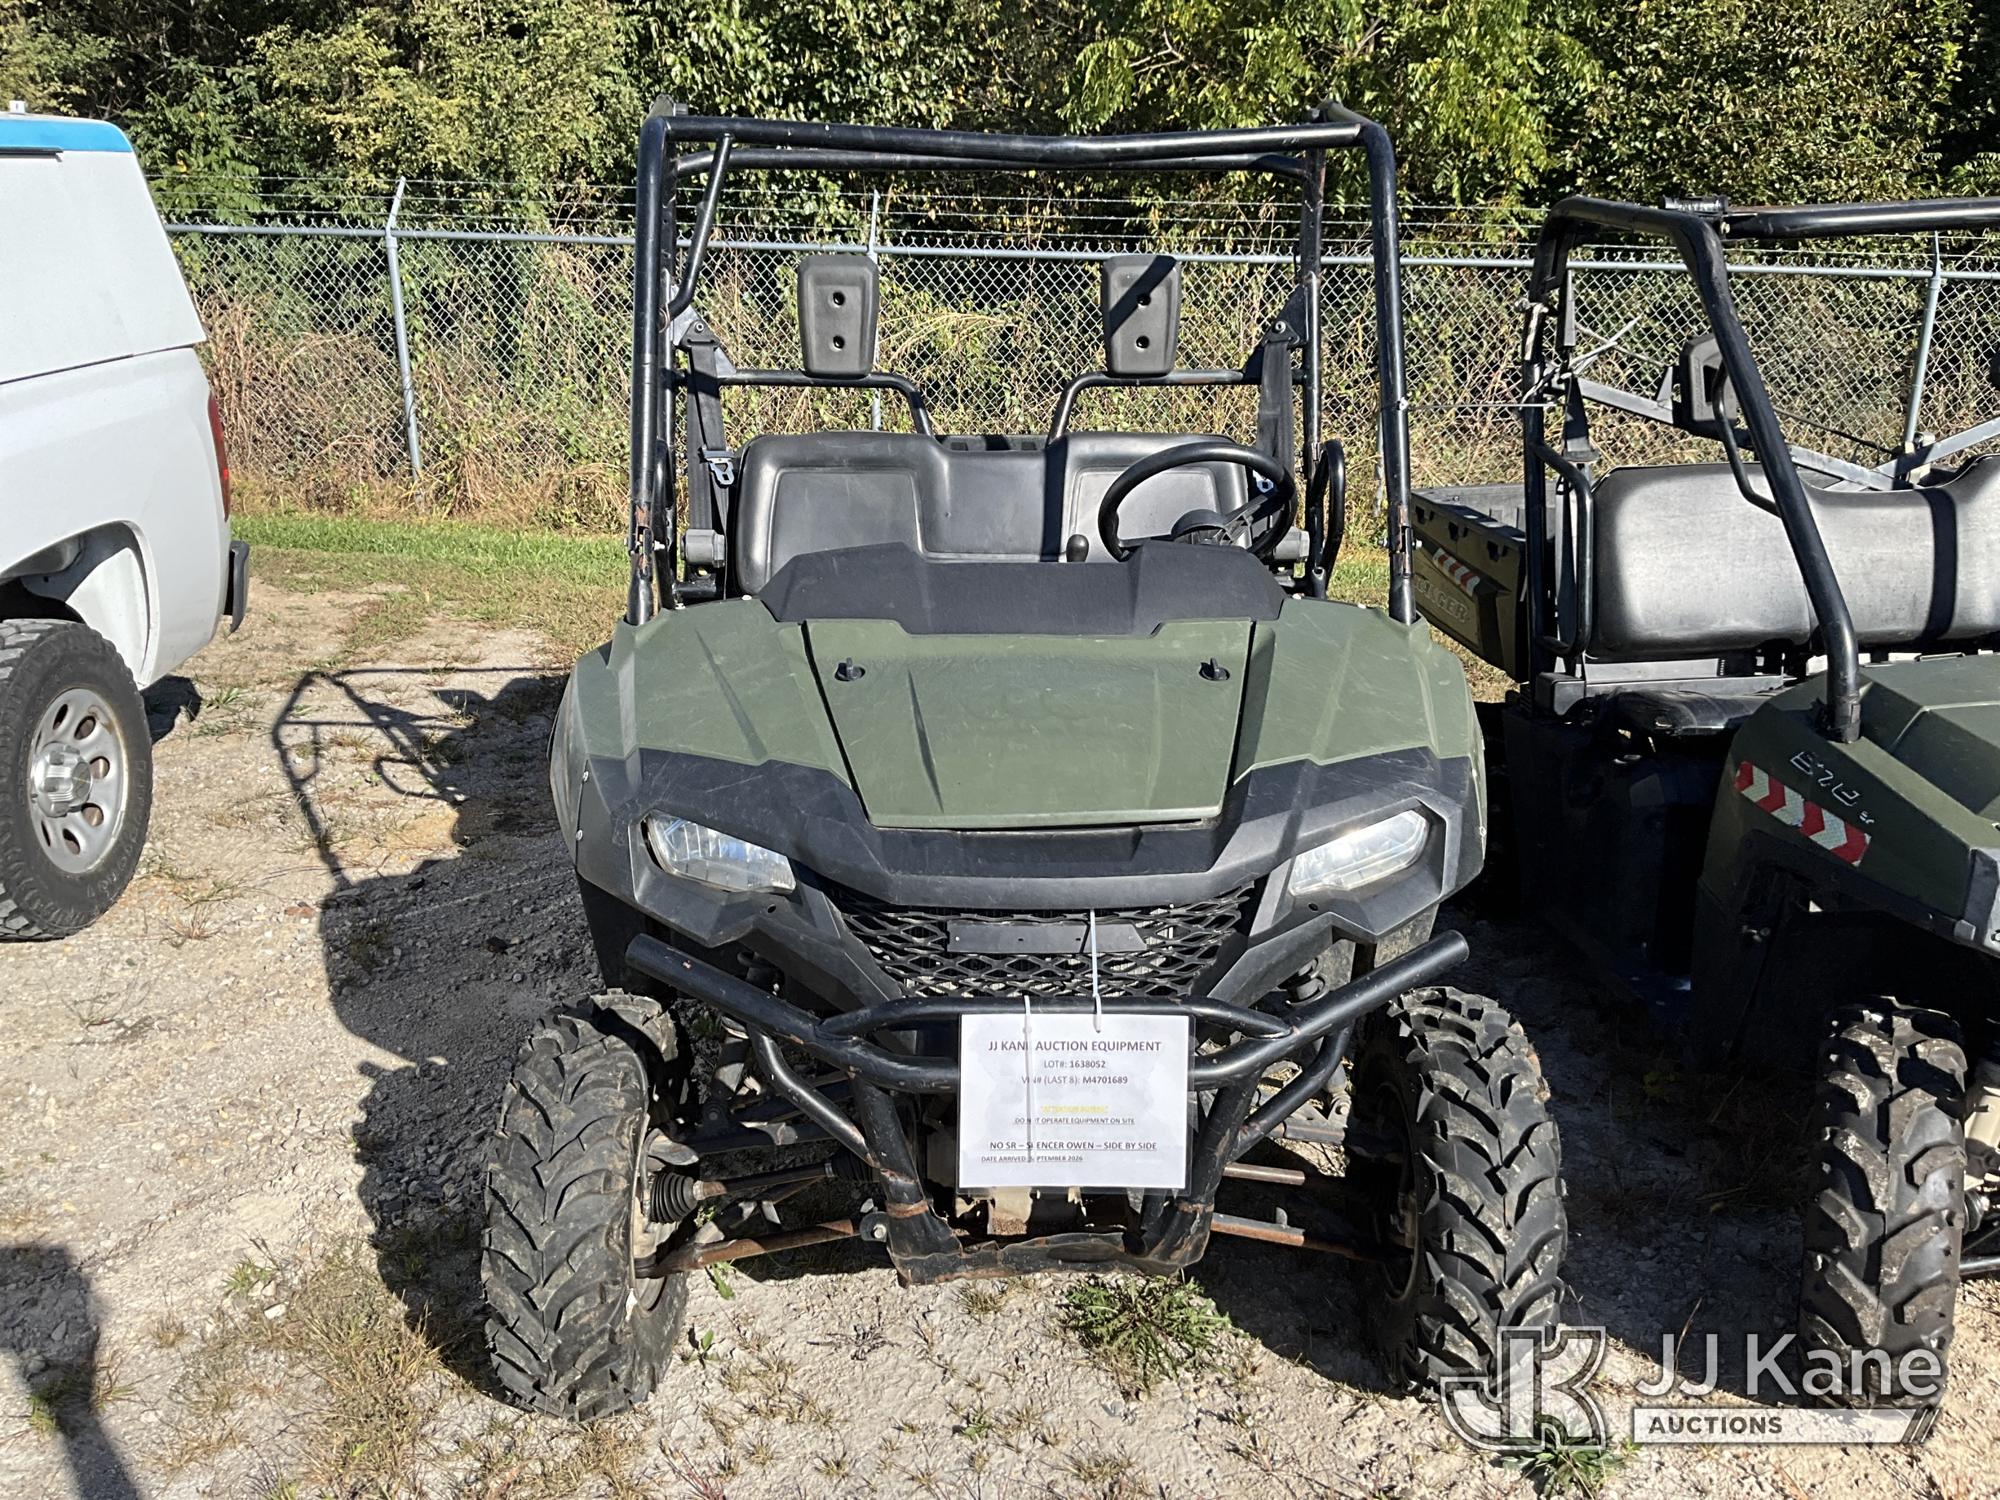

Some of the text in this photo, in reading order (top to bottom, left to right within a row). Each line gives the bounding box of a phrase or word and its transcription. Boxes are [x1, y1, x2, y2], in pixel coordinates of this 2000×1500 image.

[988, 1041, 998, 1051] JJ
[1035, 1041, 1088, 1051] AUCTION
[1091, 1041, 1162, 1052] EQUIPMENT
[1043, 1060, 1106, 1068] LOT#: 1638052
[1044, 1076, 1067, 1086] (LAST
[1082, 1076, 1128, 1084] M4701689
[1070, 1117, 1109, 1125] EQUIPMENT
[990, 1141, 1004, 1149] NO
[1005, 1141, 1016, 1149] SR
[1066, 1141, 1094, 1149] OWEN
